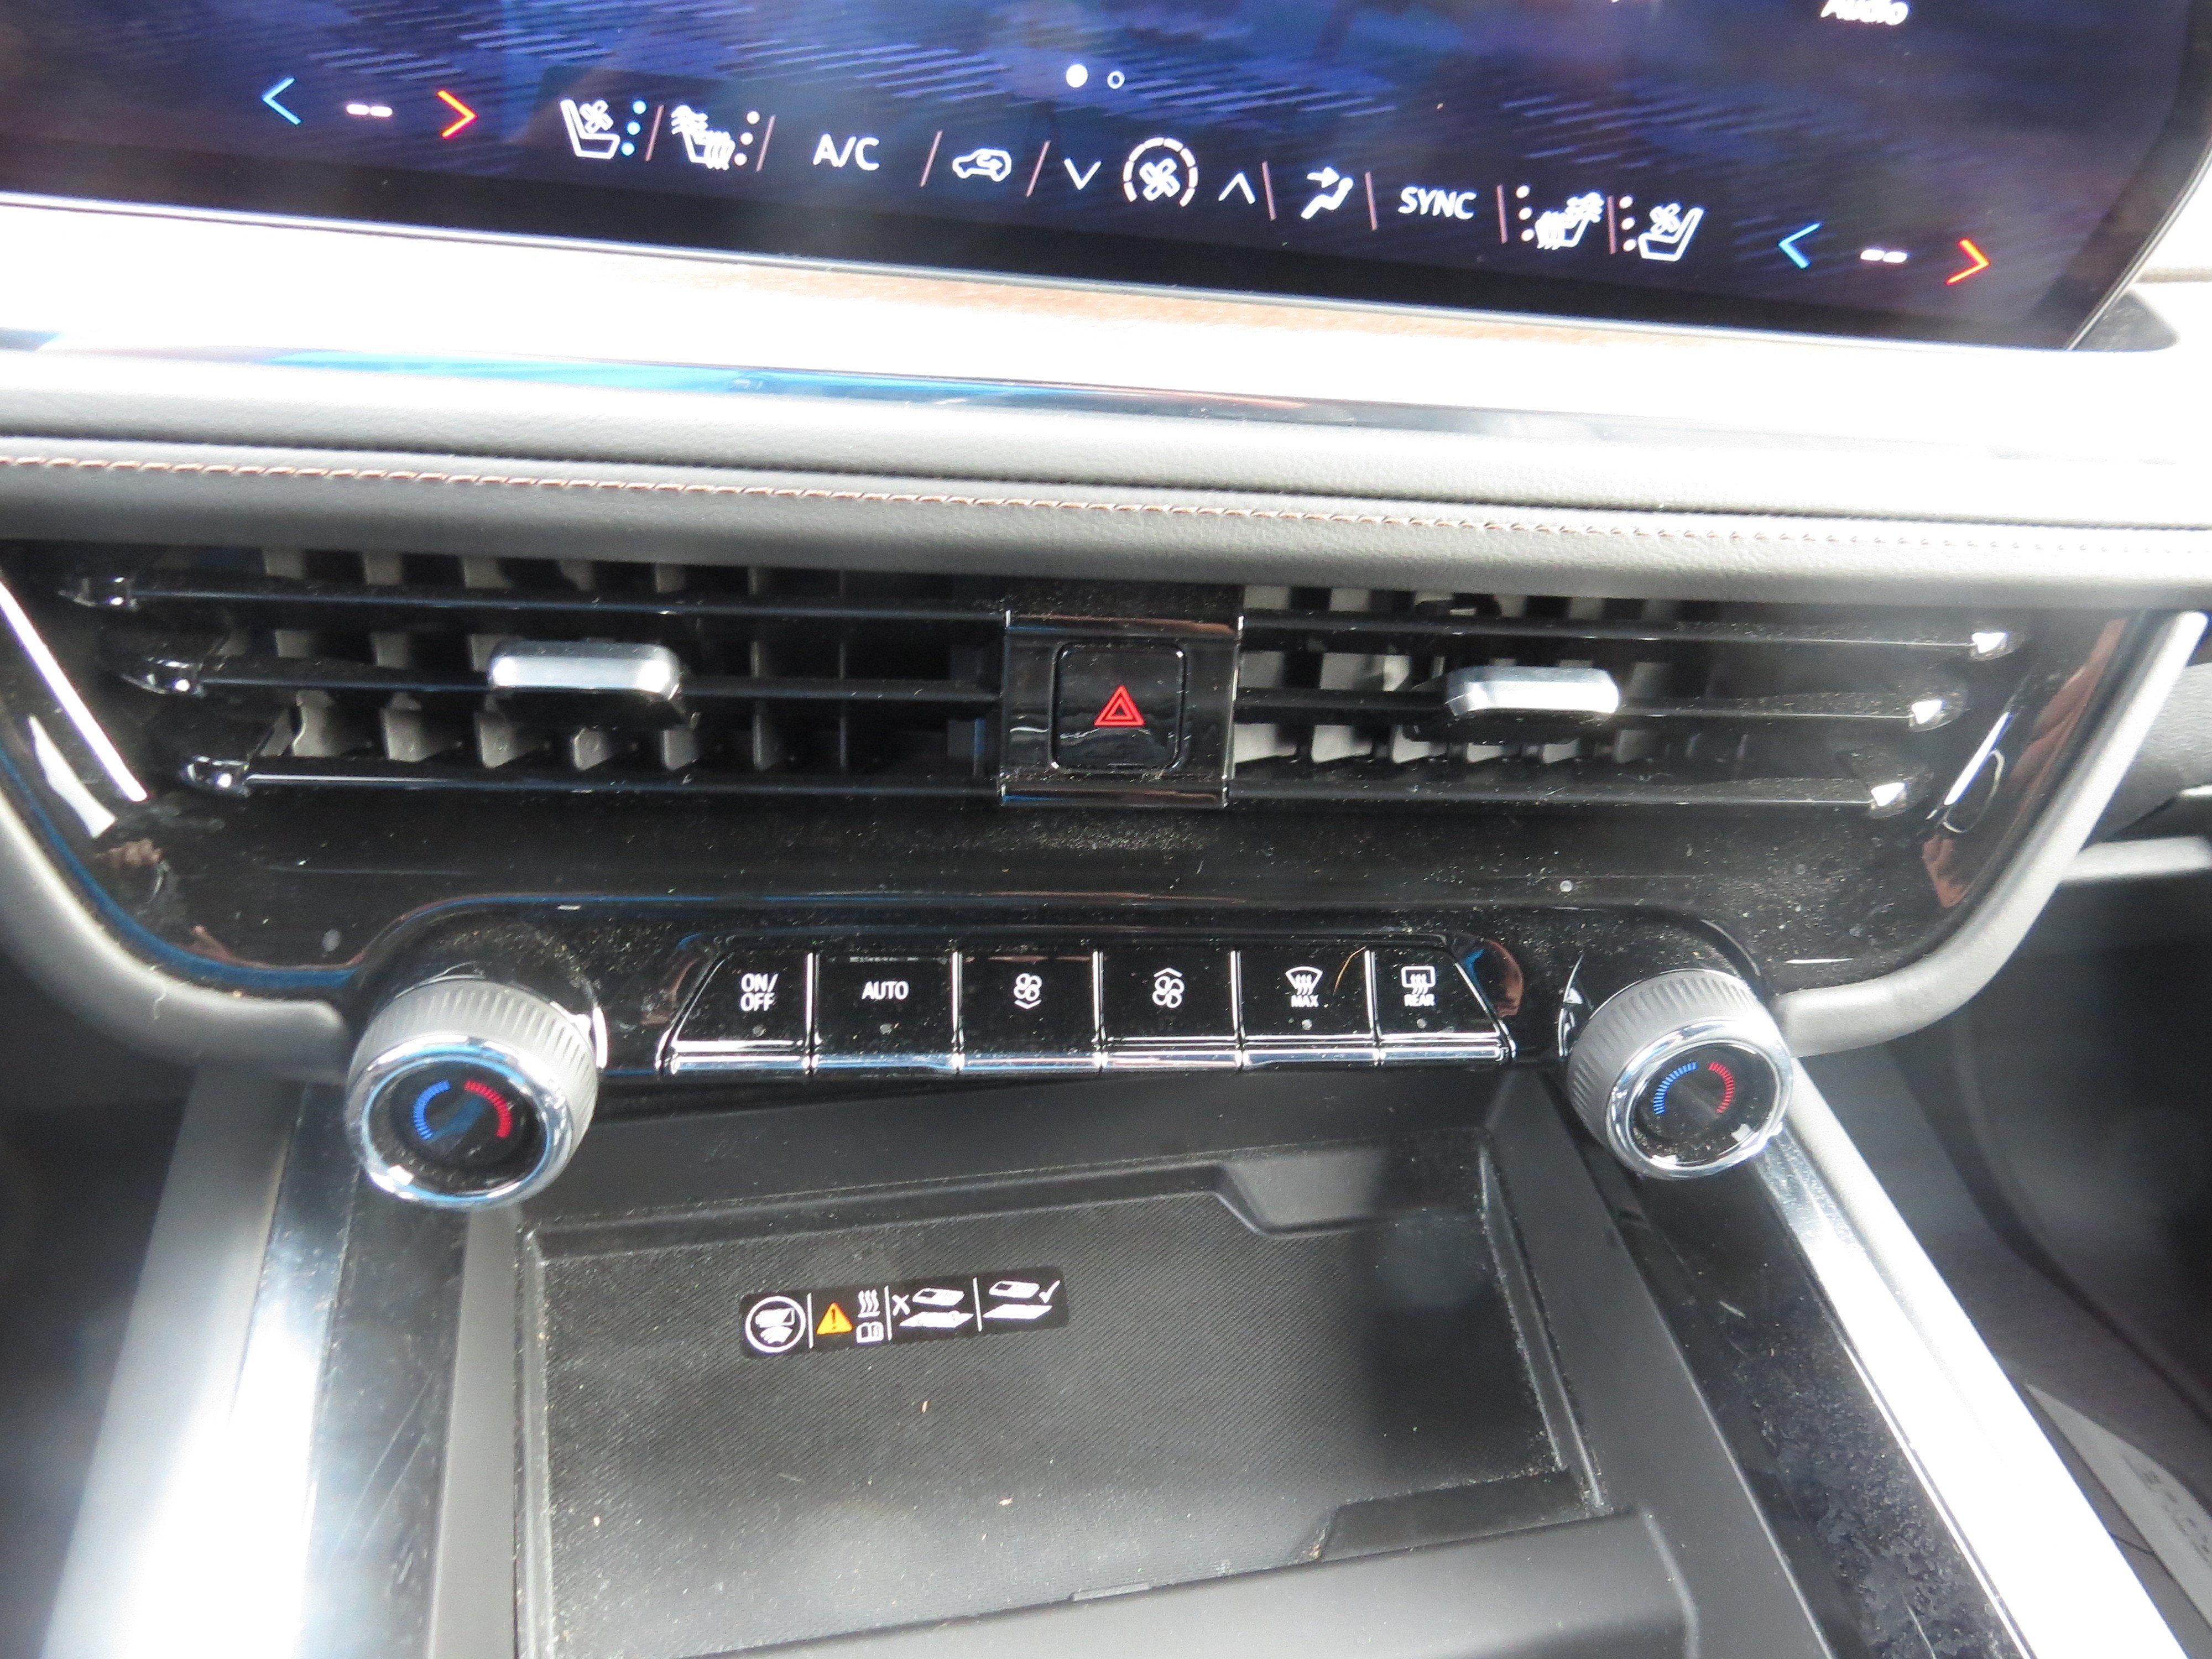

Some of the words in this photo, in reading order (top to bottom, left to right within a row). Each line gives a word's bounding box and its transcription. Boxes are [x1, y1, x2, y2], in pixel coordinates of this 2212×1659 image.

[813, 133, 879, 170] A/C
[1398, 186, 1477, 220] SYNC
[741, 973, 778, 992] ON/
[862, 981, 909, 1000] AUTO
[740, 993, 774, 1011] OFF
[1291, 995, 1319, 1008] MAX
[1404, 995, 1435, 1006] REAR
